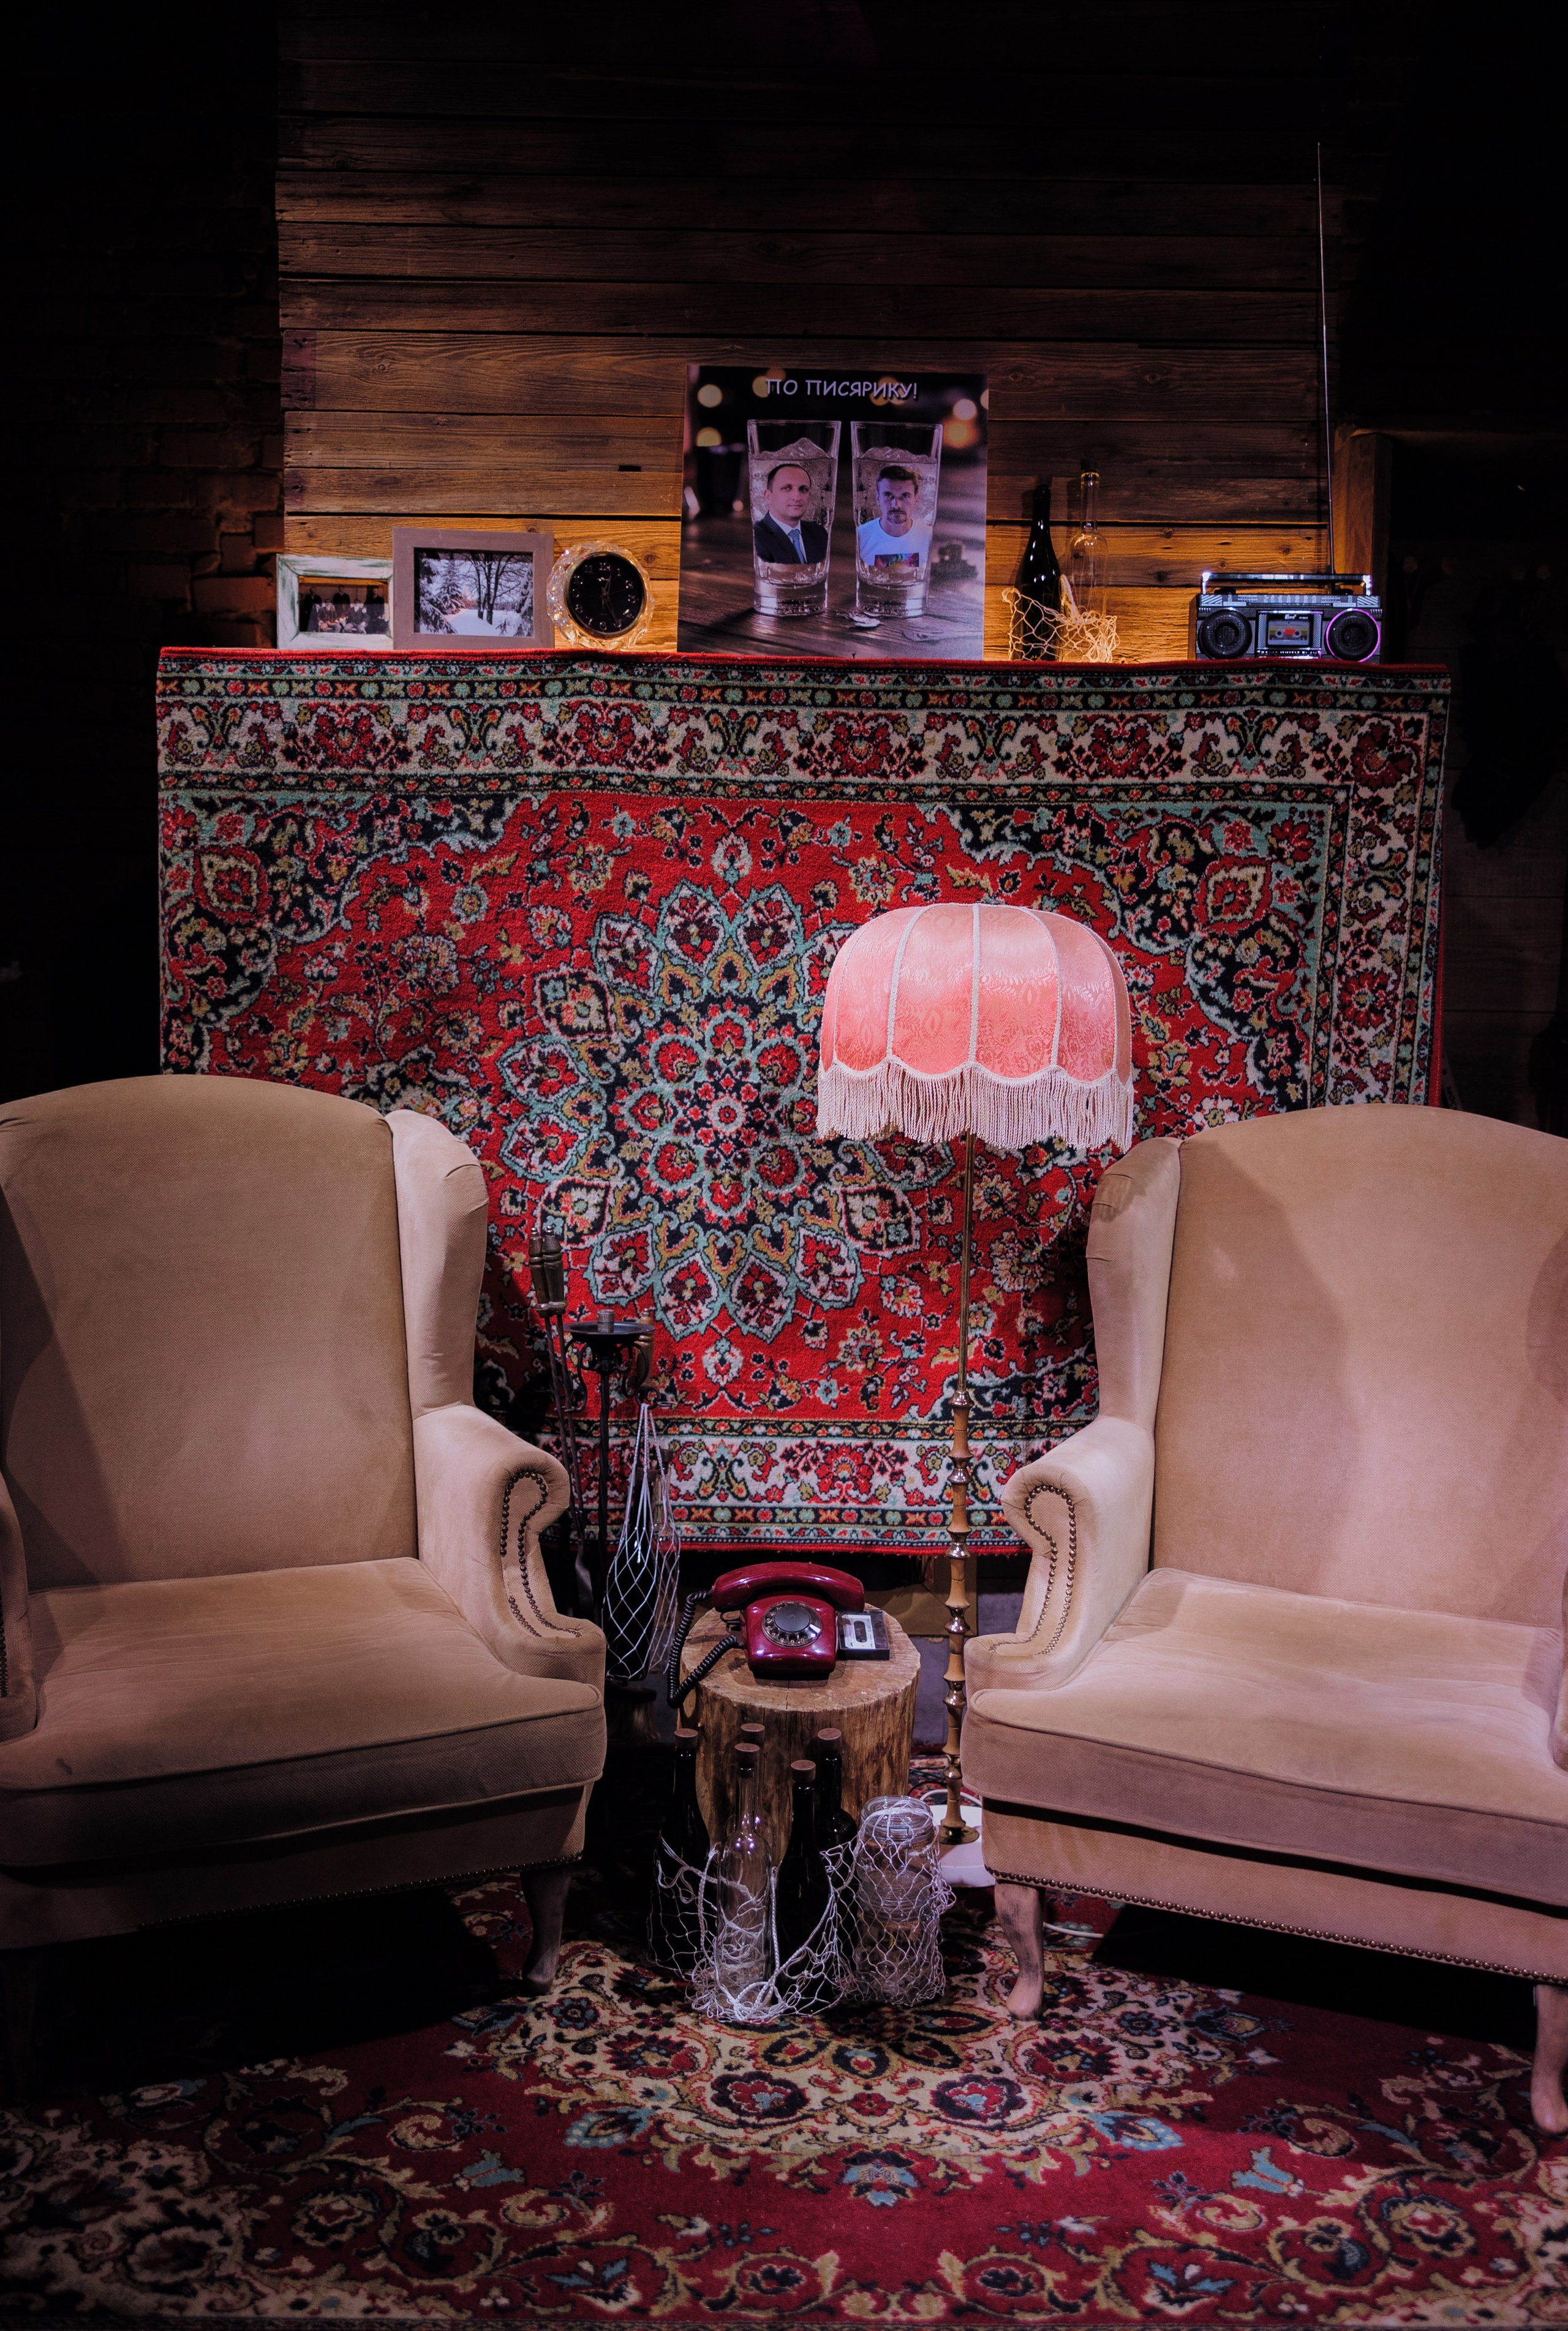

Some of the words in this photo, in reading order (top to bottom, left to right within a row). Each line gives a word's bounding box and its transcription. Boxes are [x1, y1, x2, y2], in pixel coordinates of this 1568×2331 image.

[766, 379, 798, 395] ПО
[805, 380, 918, 399] ПИСЯРИКУ!
[584, 565, 594, 573] 11
[598, 562, 611, 571] 12
[616, 568, 622, 576] 1
[625, 580, 634, 589] 2
[572, 589, 579, 598] 9
[575, 603, 583, 613] 8
[586, 616, 594, 625] 7
[599, 621, 607, 630] 6
